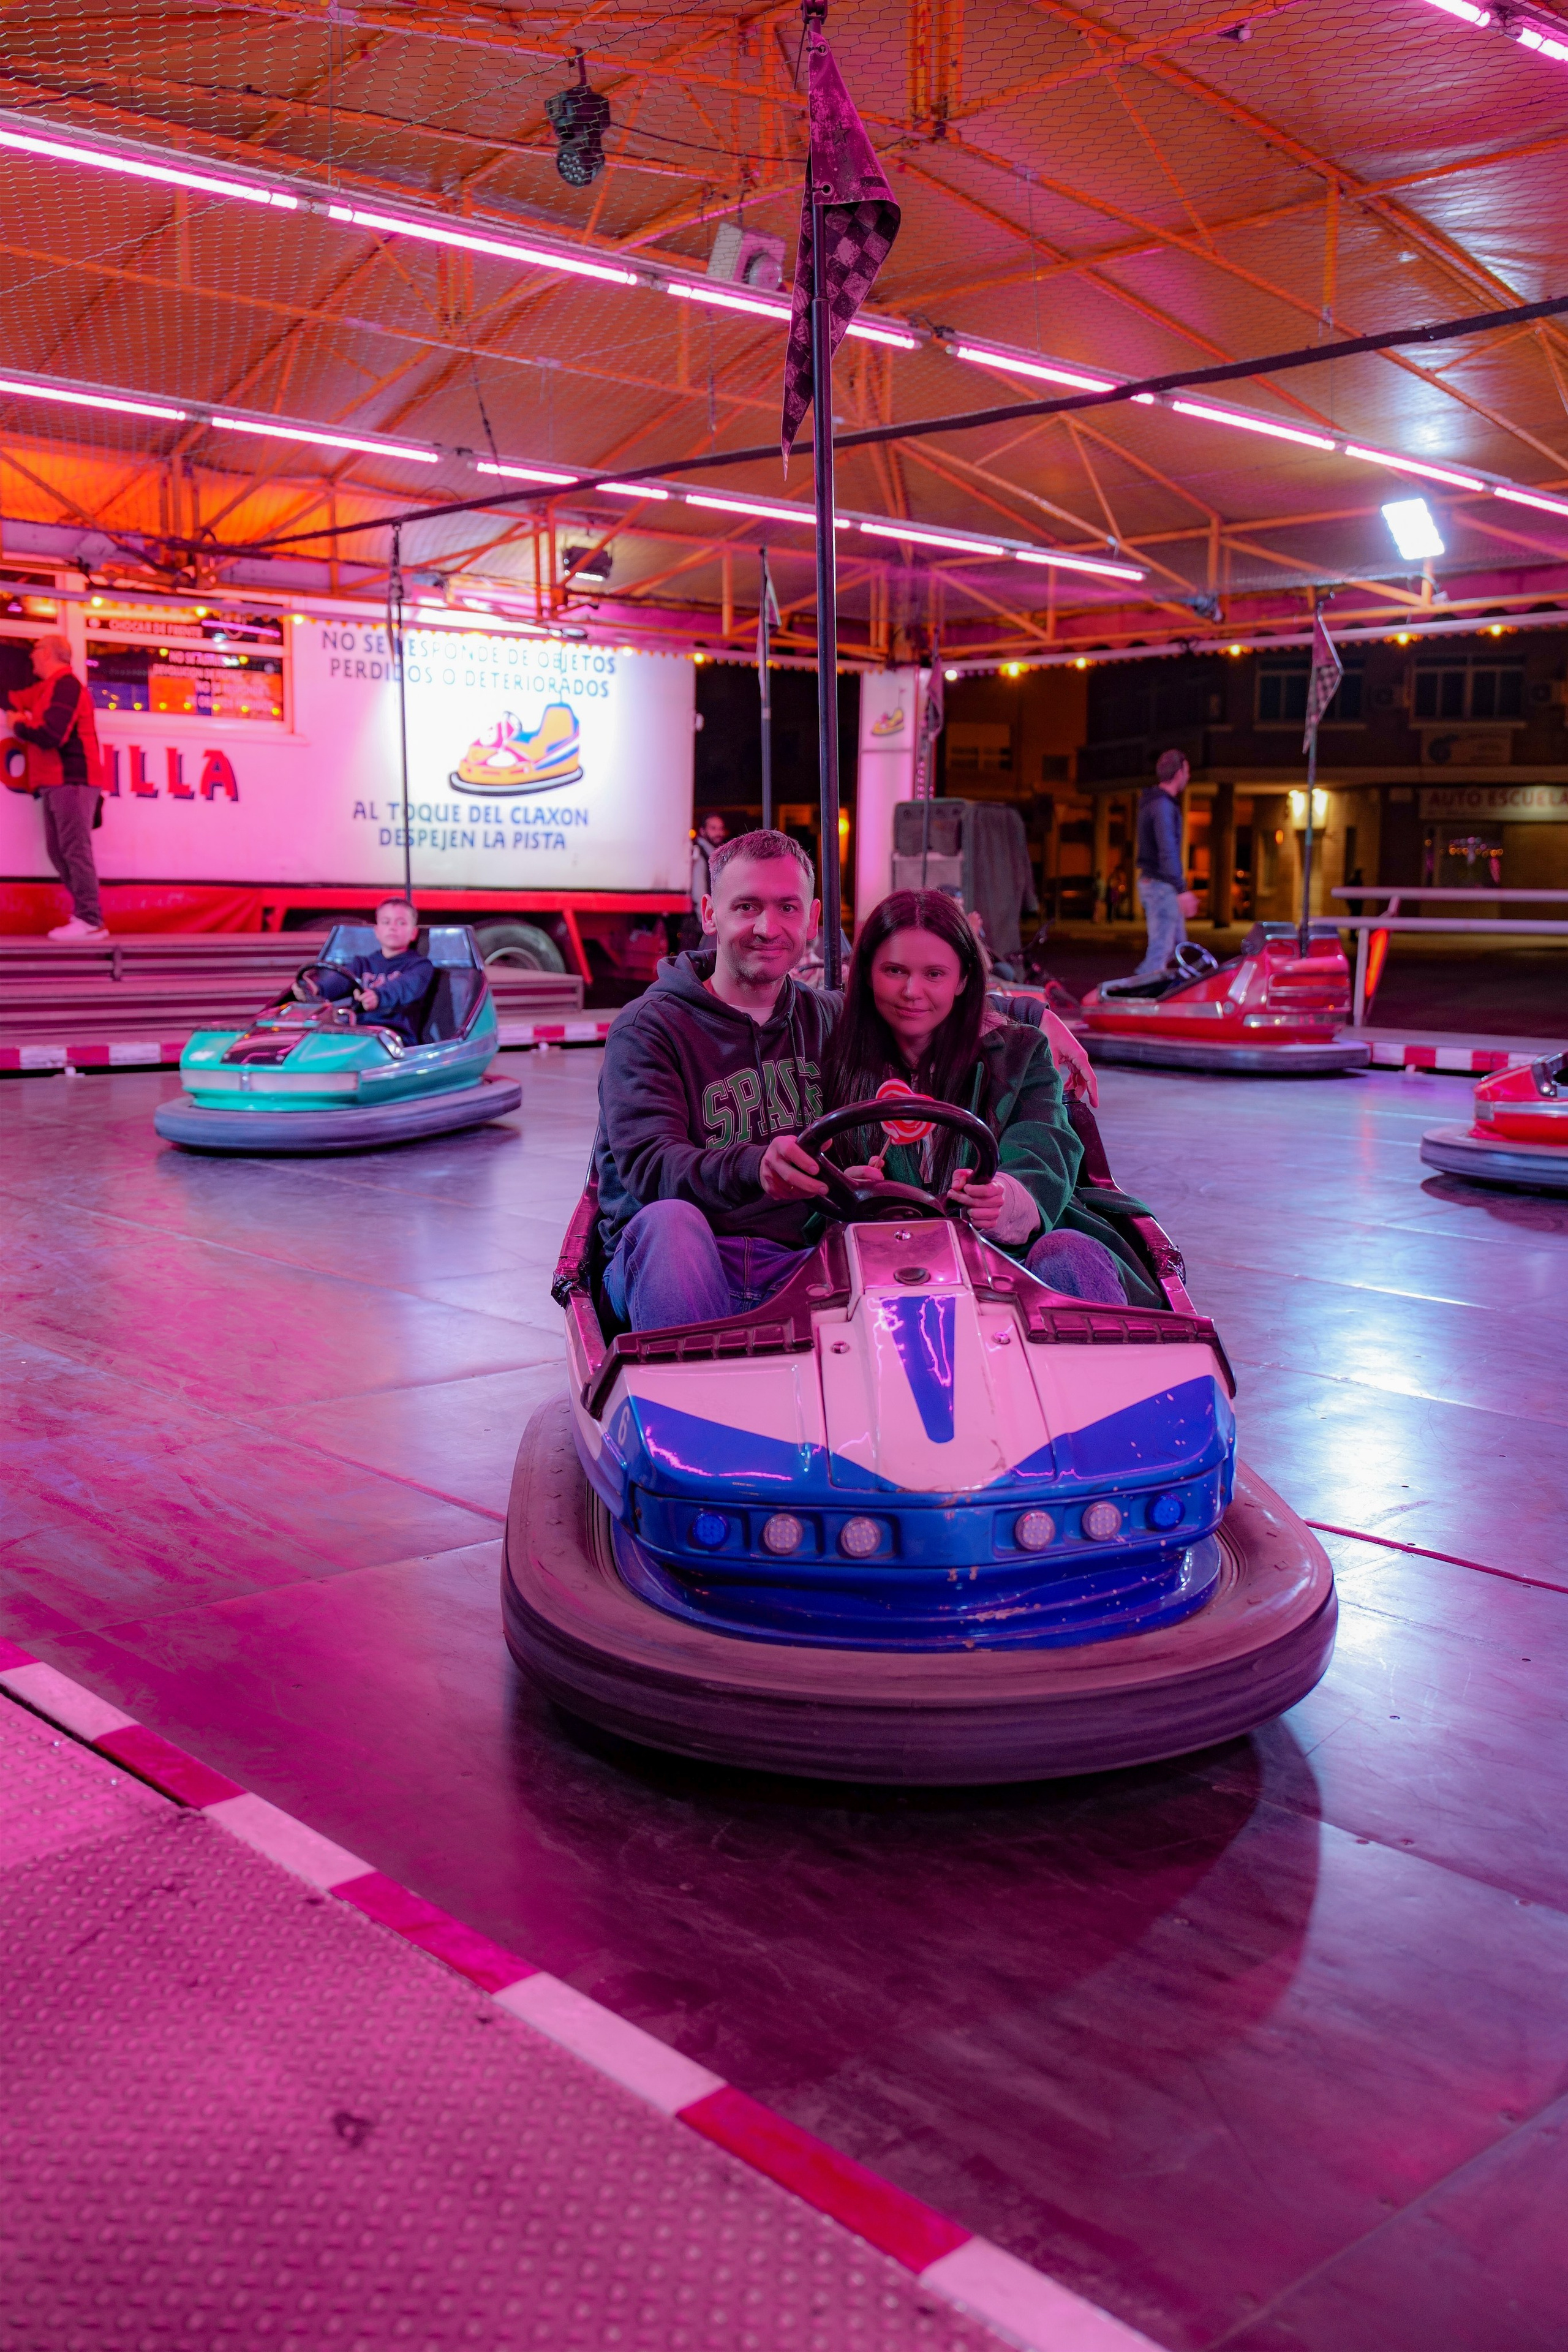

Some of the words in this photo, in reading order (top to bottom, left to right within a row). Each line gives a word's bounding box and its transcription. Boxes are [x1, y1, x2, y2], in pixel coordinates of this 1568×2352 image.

[322, 631, 355, 650] NO
[364, 635, 385, 654] SE
[508, 648, 529, 666] DE
[538, 652, 616, 674] OBJETOS
[442, 668, 456, 685] O
[466, 670, 609, 698] DETERIORADOS
[1428, 788, 1482, 807] AUTO
[353, 802, 378, 820] AL
[469, 805, 502, 823] DEL
[511, 806, 589, 826] CLAXON
[380, 828, 475, 851] DESPEJEN
[483, 831, 505, 848] LA
[513, 831, 566, 850] PISTA
[618, 1405, 630, 1446] 6
